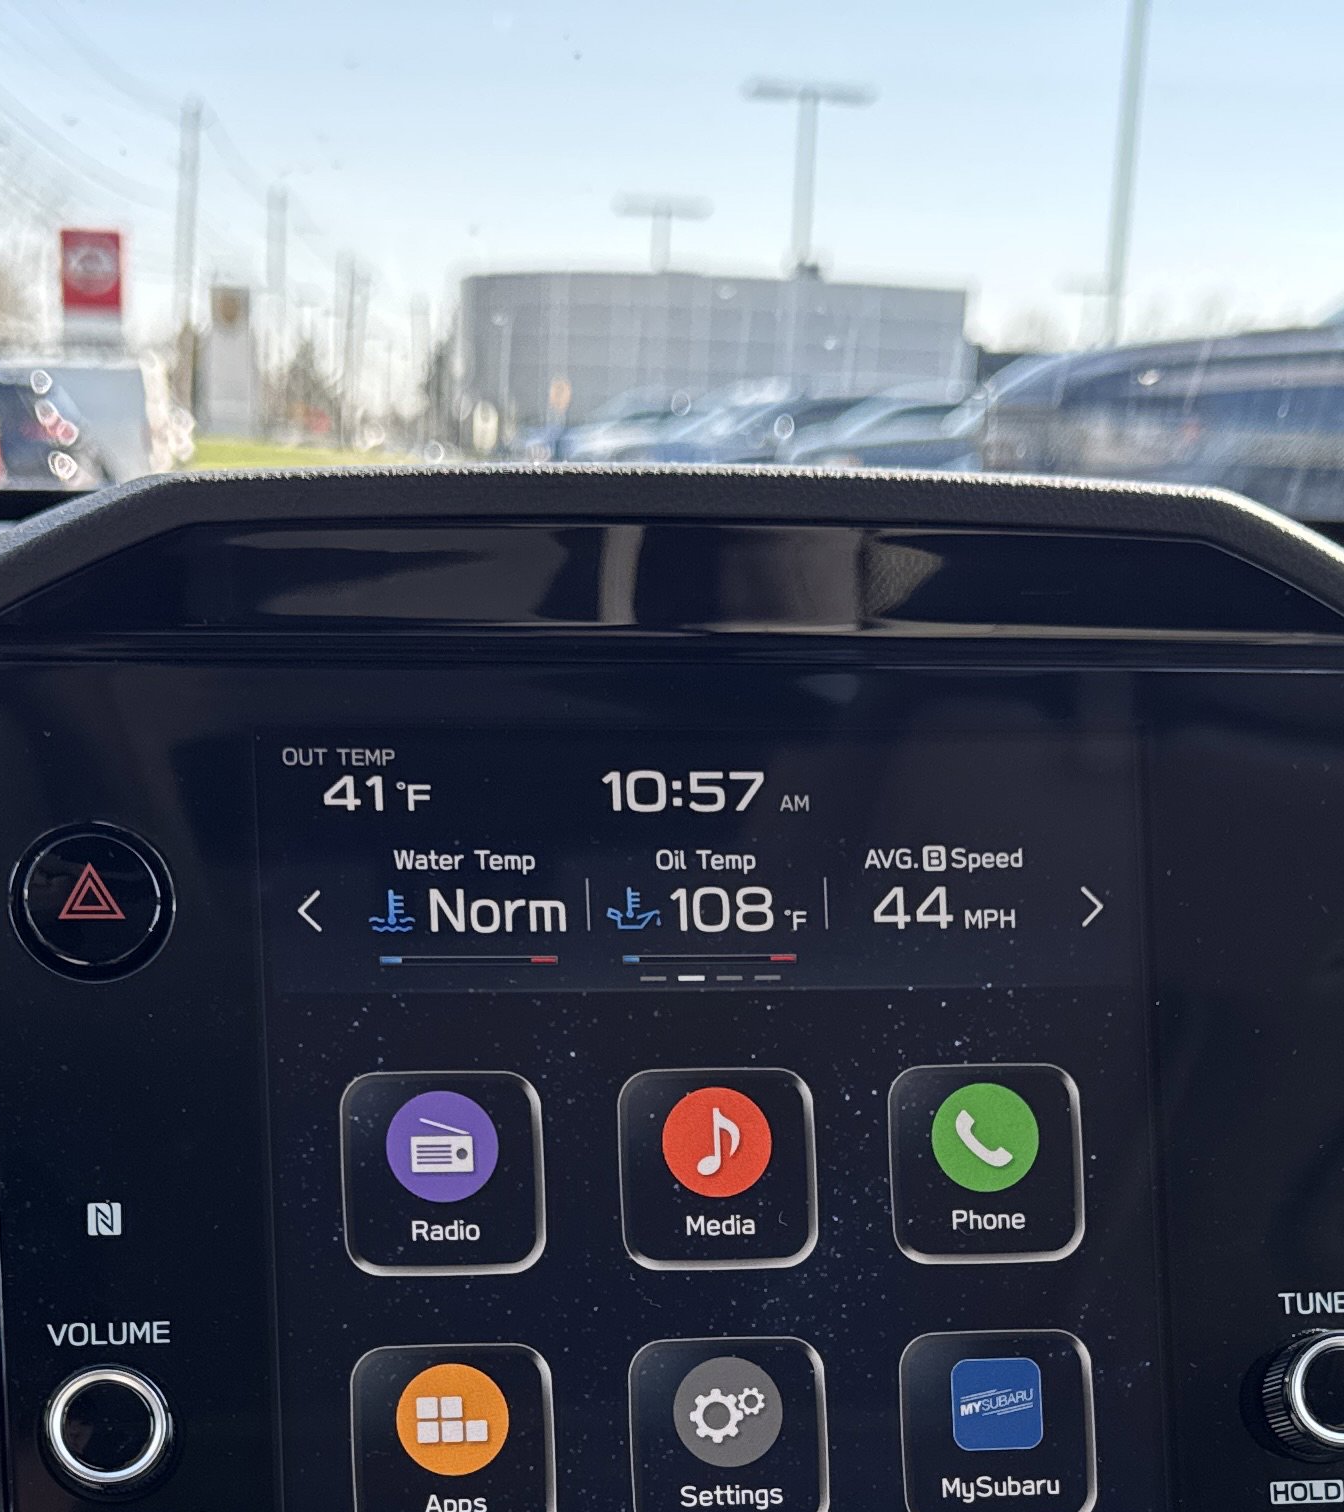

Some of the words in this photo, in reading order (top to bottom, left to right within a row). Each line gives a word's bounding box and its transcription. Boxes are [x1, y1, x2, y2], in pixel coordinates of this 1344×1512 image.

[281, 746, 327, 767] OUT
[336, 748, 396, 766] TEMP
[601, 770, 765, 813] 10:57
[779, 794, 810, 812] AM
[393, 849, 465, 871] Water
[473, 849, 536, 876] Temp
[655, 849, 687, 871] Oil
[695, 849, 757, 875] Temp
[950, 847, 1023, 873] Speed
[429, 888, 567, 934] Norm
[669, 886, 774, 933] 108
[873, 886, 954, 930] 44
[964, 908, 1016, 930] MPH
[411, 1219, 481, 1242] Radio
[685, 1214, 756, 1237] Media
[951, 1209, 1026, 1231] Phone
[46, 1320, 171, 1347] VOLUME
[680, 1484, 784, 1511] Settings
[941, 1475, 1060, 1504] MySubaru
[1272, 1482, 1341, 1502] HOLD
